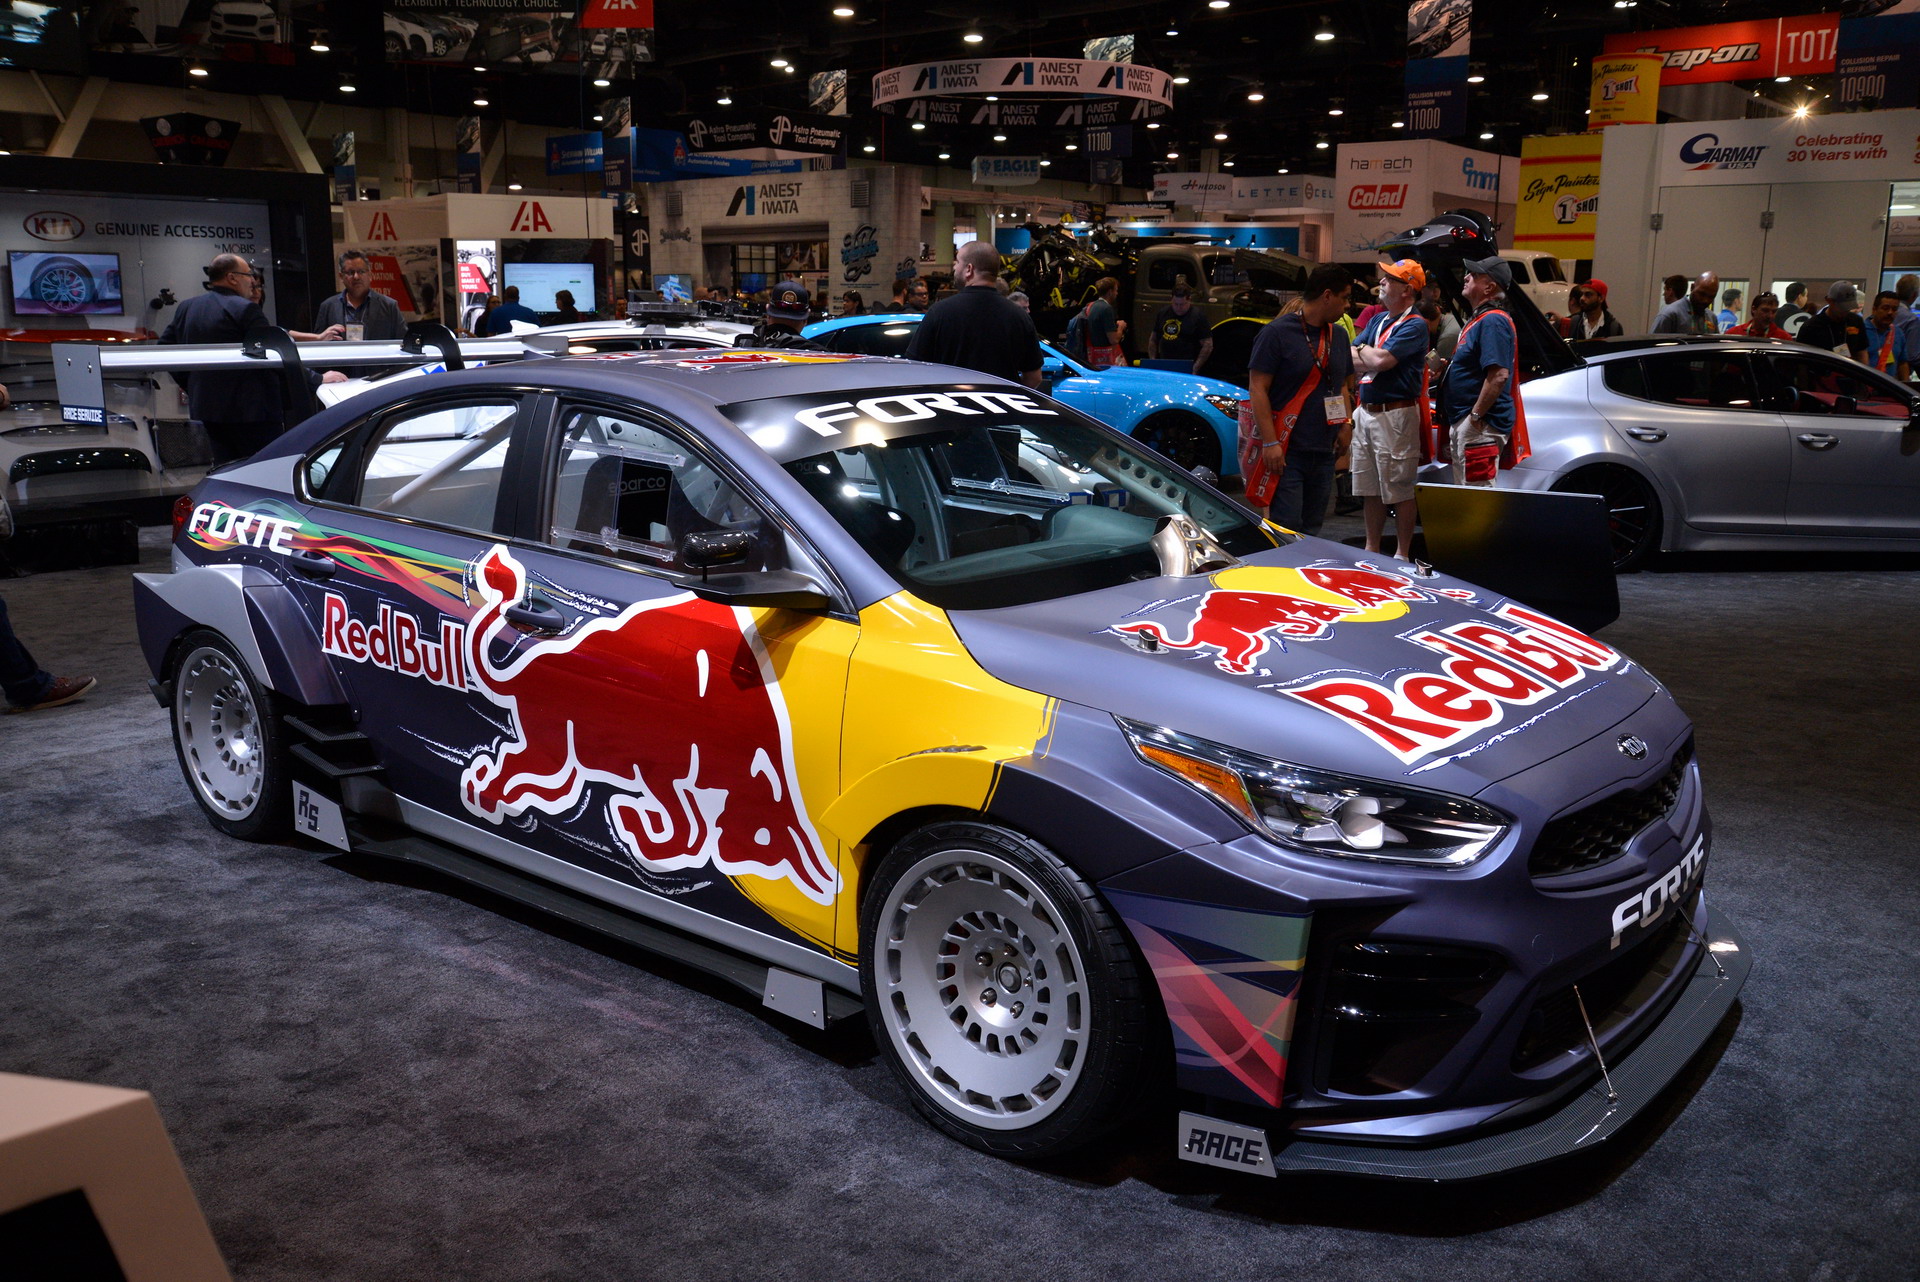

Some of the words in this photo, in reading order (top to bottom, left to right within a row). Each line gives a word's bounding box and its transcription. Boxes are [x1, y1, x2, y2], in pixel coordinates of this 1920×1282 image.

[1840, 56, 1875, 65] COLLISION
[1876, 54, 1901, 62] REPAIR
[941, 63, 982, 76] ANEST
[1039, 62, 1082, 75] ANEST
[1127, 68, 1154, 82] ANEST
[1846, 65, 1877, 73] REFINISH
[881, 72, 901, 87] ANEST
[943, 76, 978, 88] IWATA
[1041, 75, 1079, 87] IWATA
[1615, 79, 1633, 91] SHOT
[881, 84, 899, 98] IWATA
[1128, 81, 1152, 94] IWATA
[929, 102, 962, 113] ANEST
[1002, 104, 1040, 115] ANEST
[1086, 102, 1119, 114] ANEST
[930, 113, 959, 124] IWATA
[1003, 115, 1037, 126] IWATA
[1087, 113, 1116, 125] IWATA
[1409, 107, 1440, 131] 11000
[709, 125, 725, 134] Astro
[726, 122, 757, 133] Pneumatic
[792, 125, 809, 134] Astro
[810, 127, 841, 138] Pneumatic
[713, 135, 727, 143] Tool
[728, 133, 755, 142] Company
[795, 135, 808, 143] Tool
[808, 136, 837, 148] Company
[1087, 131, 1112, 152] 11100
[1795, 132, 1884, 147] Celebrating
[1680, 133, 1766, 164] GARMAT
[1787, 149, 1807, 162] 30
[1809, 149, 1851, 161] Years
[1854, 147, 1887, 160] with
[993, 159, 1038, 172] EAGLE
[1351, 155, 1412, 170] hamach
[759, 183, 803, 198] ANEST
[1350, 183, 1405, 208] Colad
[1524, 178, 1554, 203] Sign
[762, 200, 799, 215] IWATA
[1358, 211, 1385, 219] inventing
[34, 217, 76, 235] KIA
[95, 222, 160, 237] GENUINE
[164, 224, 255, 240] ACCESSORIES
[221, 243, 256, 254] MOBIS
[63, 406, 77, 421] RACE
[77, 407, 102, 423] SERVICE
[794, 391, 1060, 438] FORTE
[188, 502, 304, 557] FORTE
[298, 789, 319, 833] RS
[1610, 832, 1704, 950] FORTE
[1186, 1127, 1263, 1166] RACE
